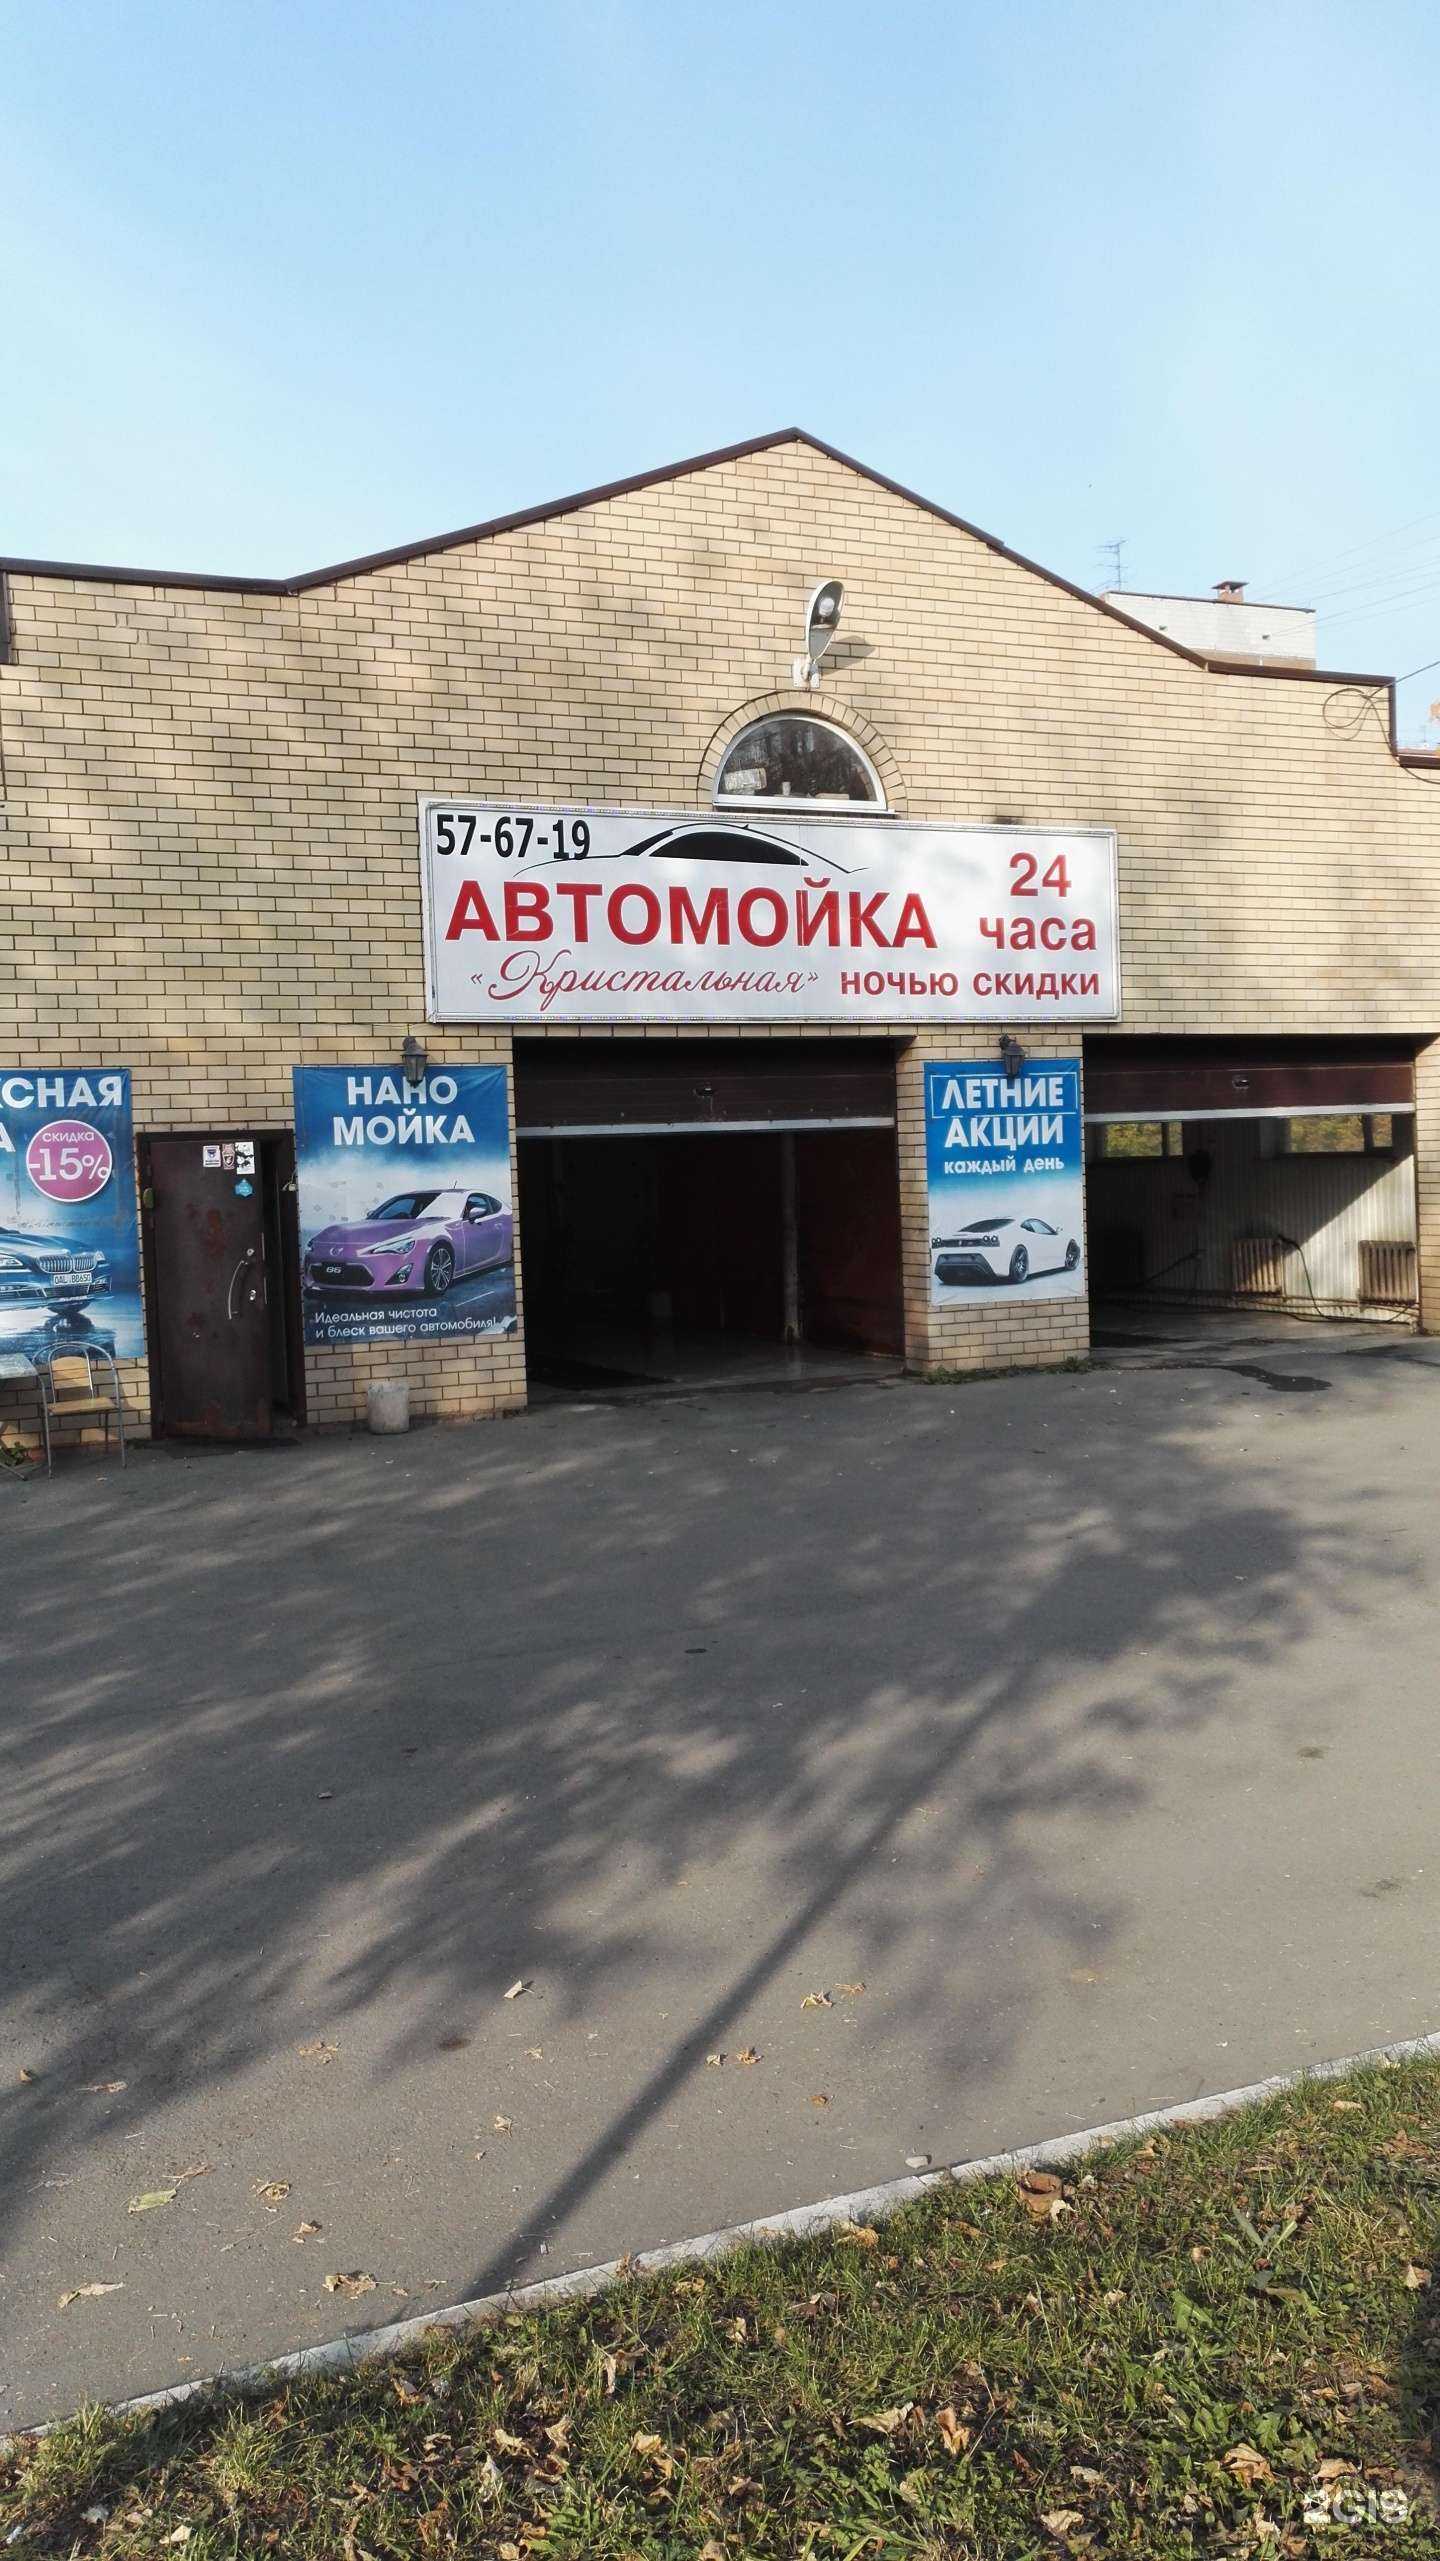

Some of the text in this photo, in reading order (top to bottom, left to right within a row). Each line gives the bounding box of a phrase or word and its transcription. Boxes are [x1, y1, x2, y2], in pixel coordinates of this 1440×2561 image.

[437, 813, 591, 860] 57-67-19
[1009, 851, 1072, 897] 24
[445, 877, 938, 949] АВТОМОЙКА
[979, 917, 1096, 950] часа
[841, 971, 1100, 1000] ночью скидки
[0, 1076, 123, 1109] СНАЯ
[347, 1075, 458, 1105] НАНО
[941, 1077, 1064, 1110] ЛЕТНИЕ
[42, 1131, 95, 1143] скидка
[332, 1107, 476, 1146] МОЙКА
[944, 1115, 1064, 1151] АКЦИИ
[28, 1147, 109, 1181] -15%
[944, 1156, 1065, 1175] каждый день
[315, 1308, 438, 1324] Идеальная чистота
[315, 1316, 497, 1339] и блеск вашего автомобиля!
